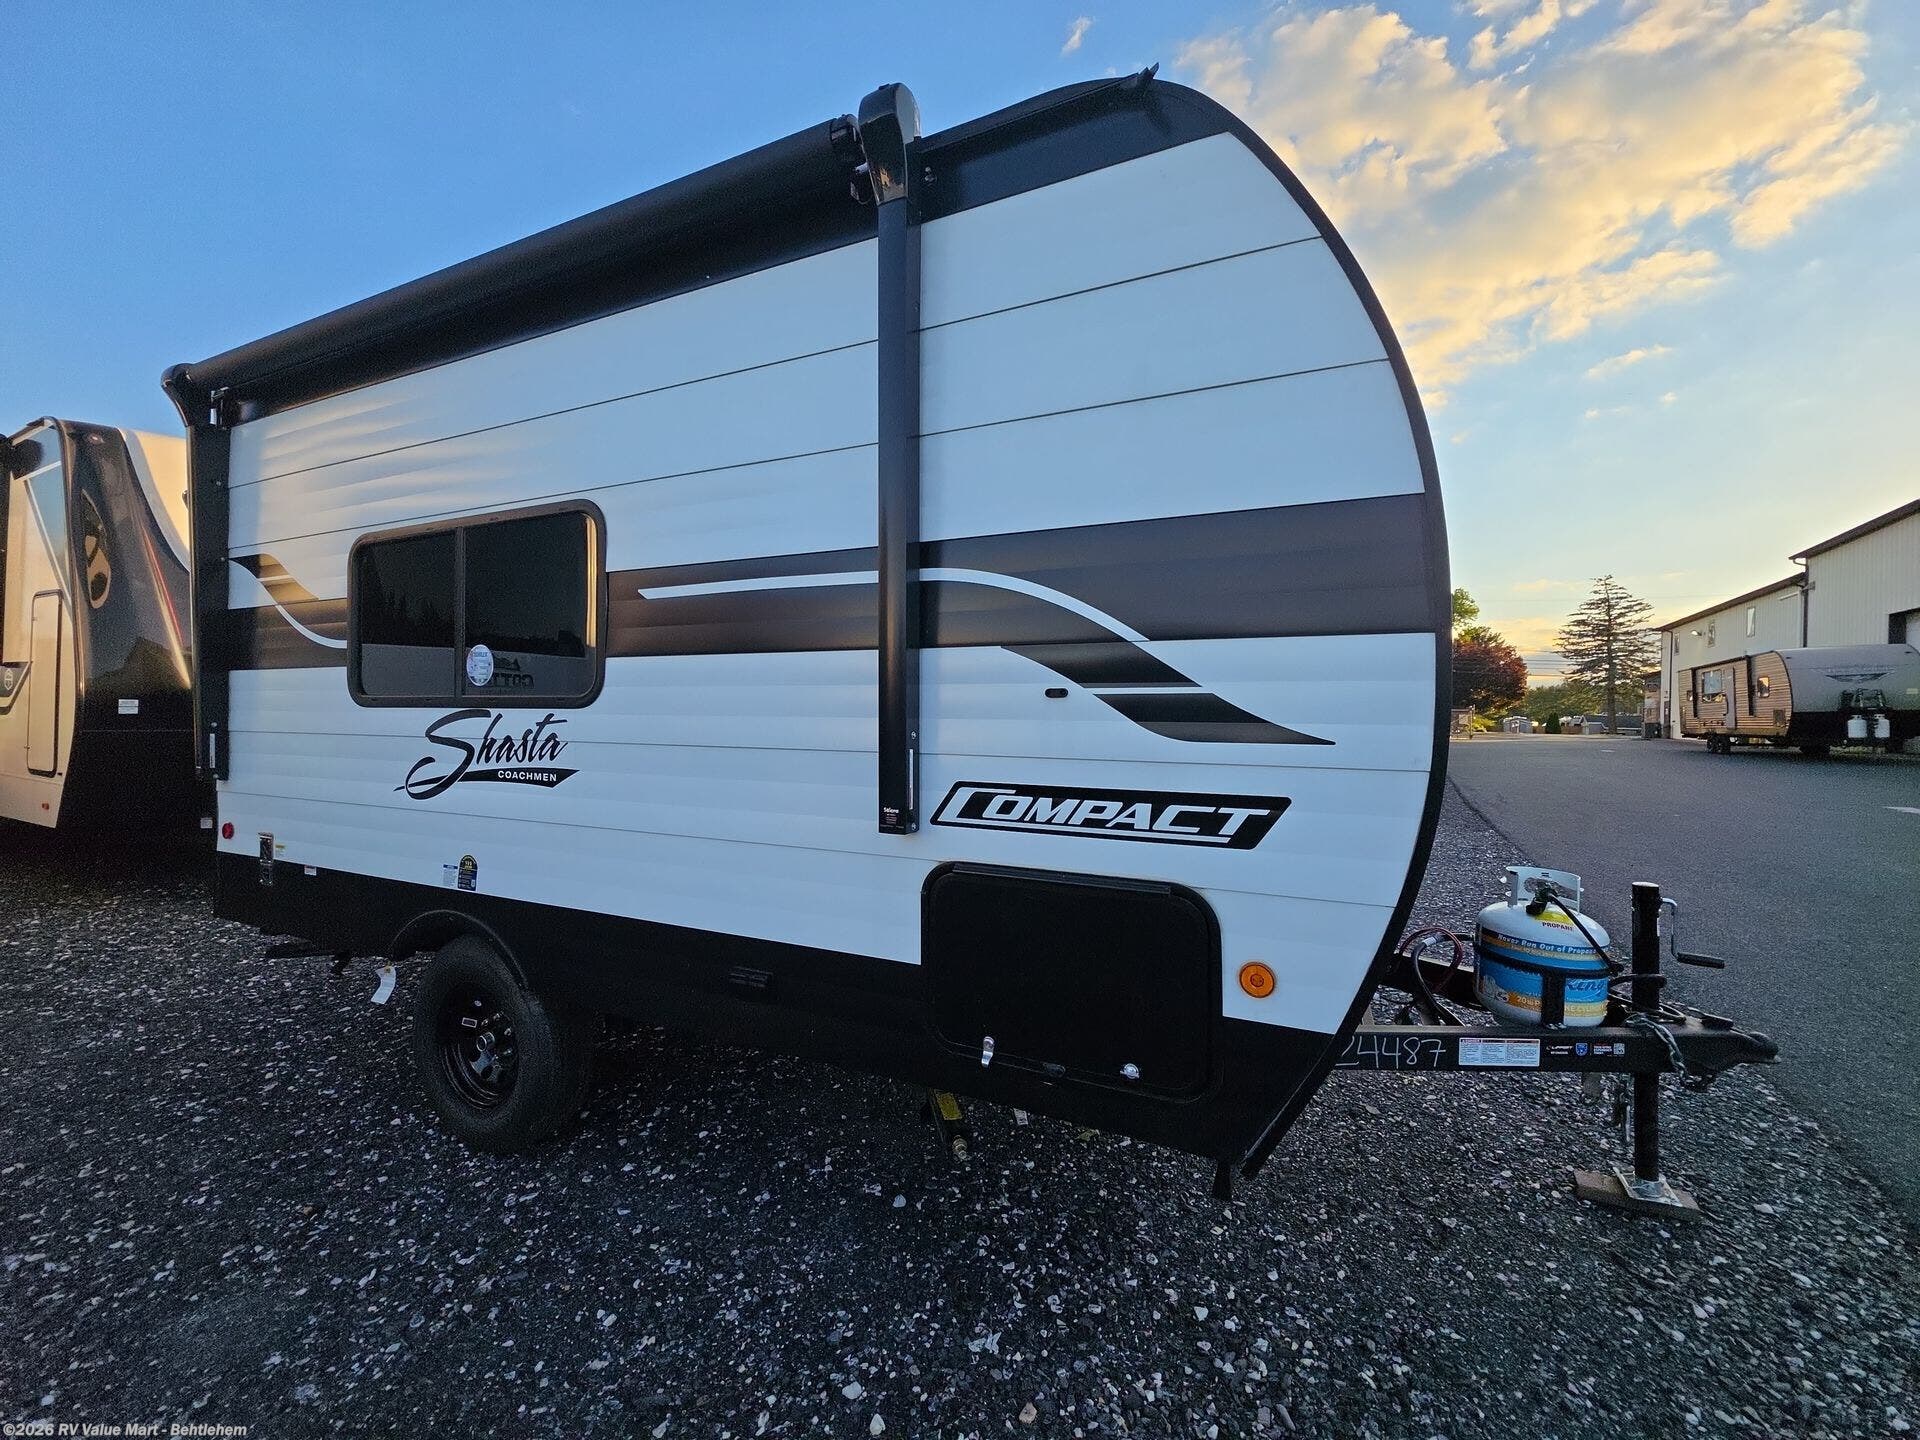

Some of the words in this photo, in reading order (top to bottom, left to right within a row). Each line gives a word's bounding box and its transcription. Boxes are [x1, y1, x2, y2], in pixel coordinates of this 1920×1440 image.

[405, 709, 568, 800] Shasta
[498, 770, 557, 782] COACHMEN
[937, 786, 1270, 843] COMPACT
[1498, 934, 1519, 945] Never
[1521, 939, 1537, 949] Run
[1539, 944, 1555, 952] Out
